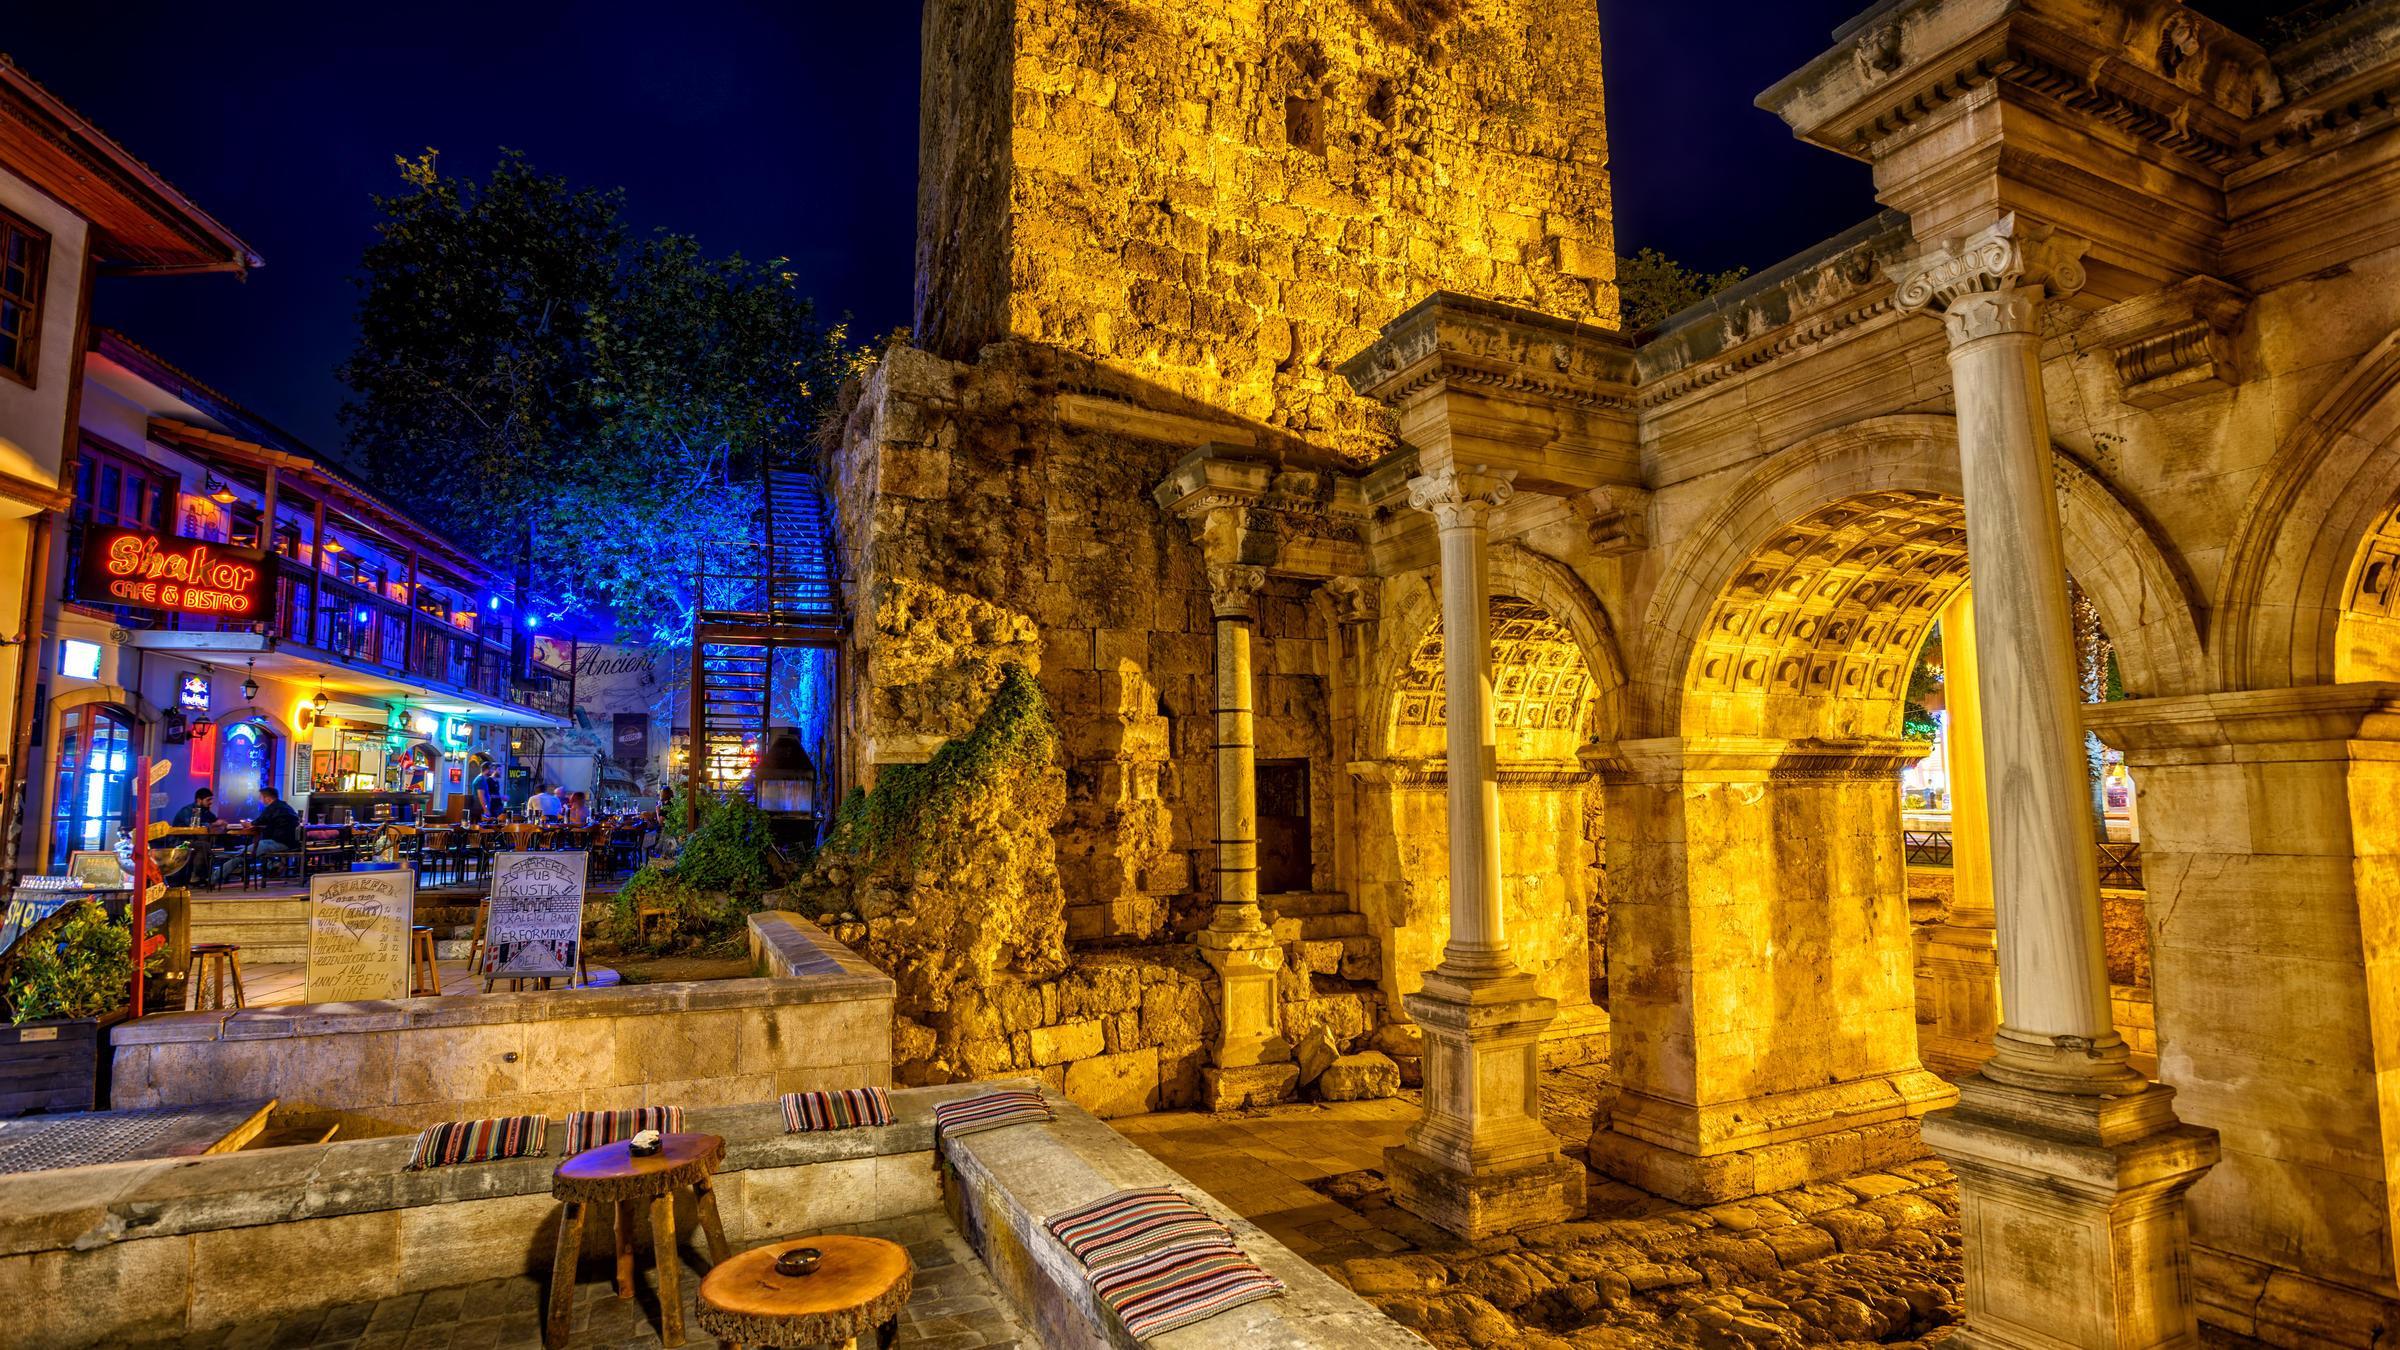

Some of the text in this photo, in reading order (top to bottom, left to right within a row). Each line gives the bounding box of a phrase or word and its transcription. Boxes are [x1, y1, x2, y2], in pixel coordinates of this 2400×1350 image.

[108, 535, 254, 591] Shaker
[111, 579, 249, 612] CAFE & BISTRO
[562, 644, 657, 676] Ancient
[509, 769, 521, 779] WC
[525, 870, 550, 881] PUB
[338, 963, 366, 976] AND
